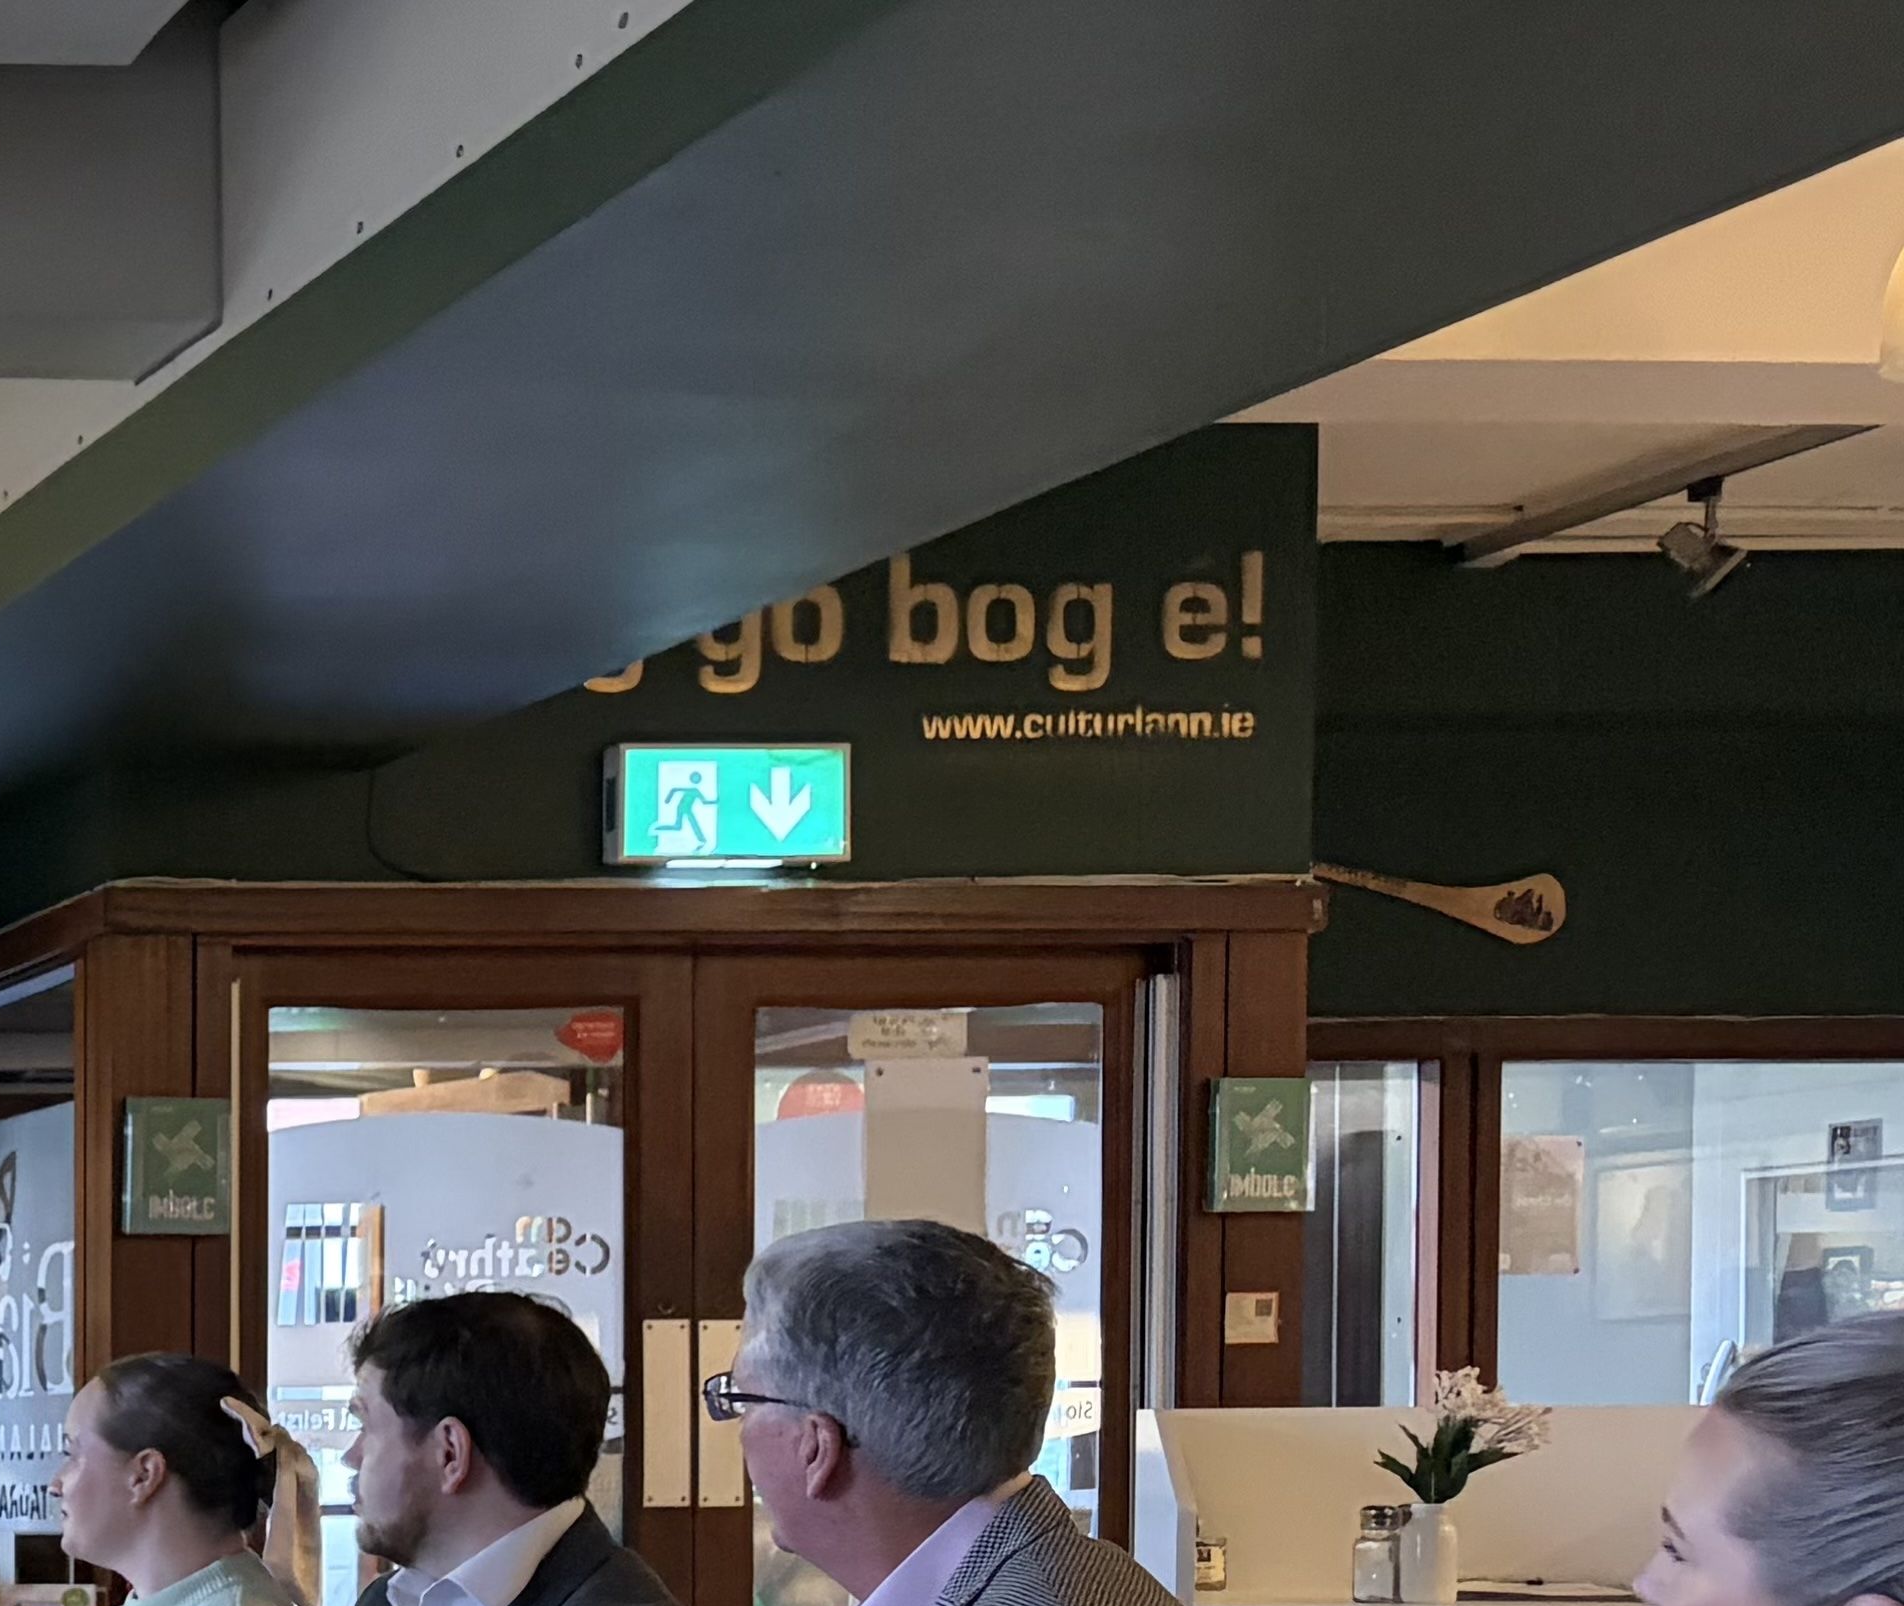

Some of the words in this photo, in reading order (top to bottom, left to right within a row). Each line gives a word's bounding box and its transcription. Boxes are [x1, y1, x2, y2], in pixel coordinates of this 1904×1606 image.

[888, 551, 1114, 692] bog
[1163, 550, 1264, 661] e!
[922, 703, 1256, 741] www.culturlann.ie
